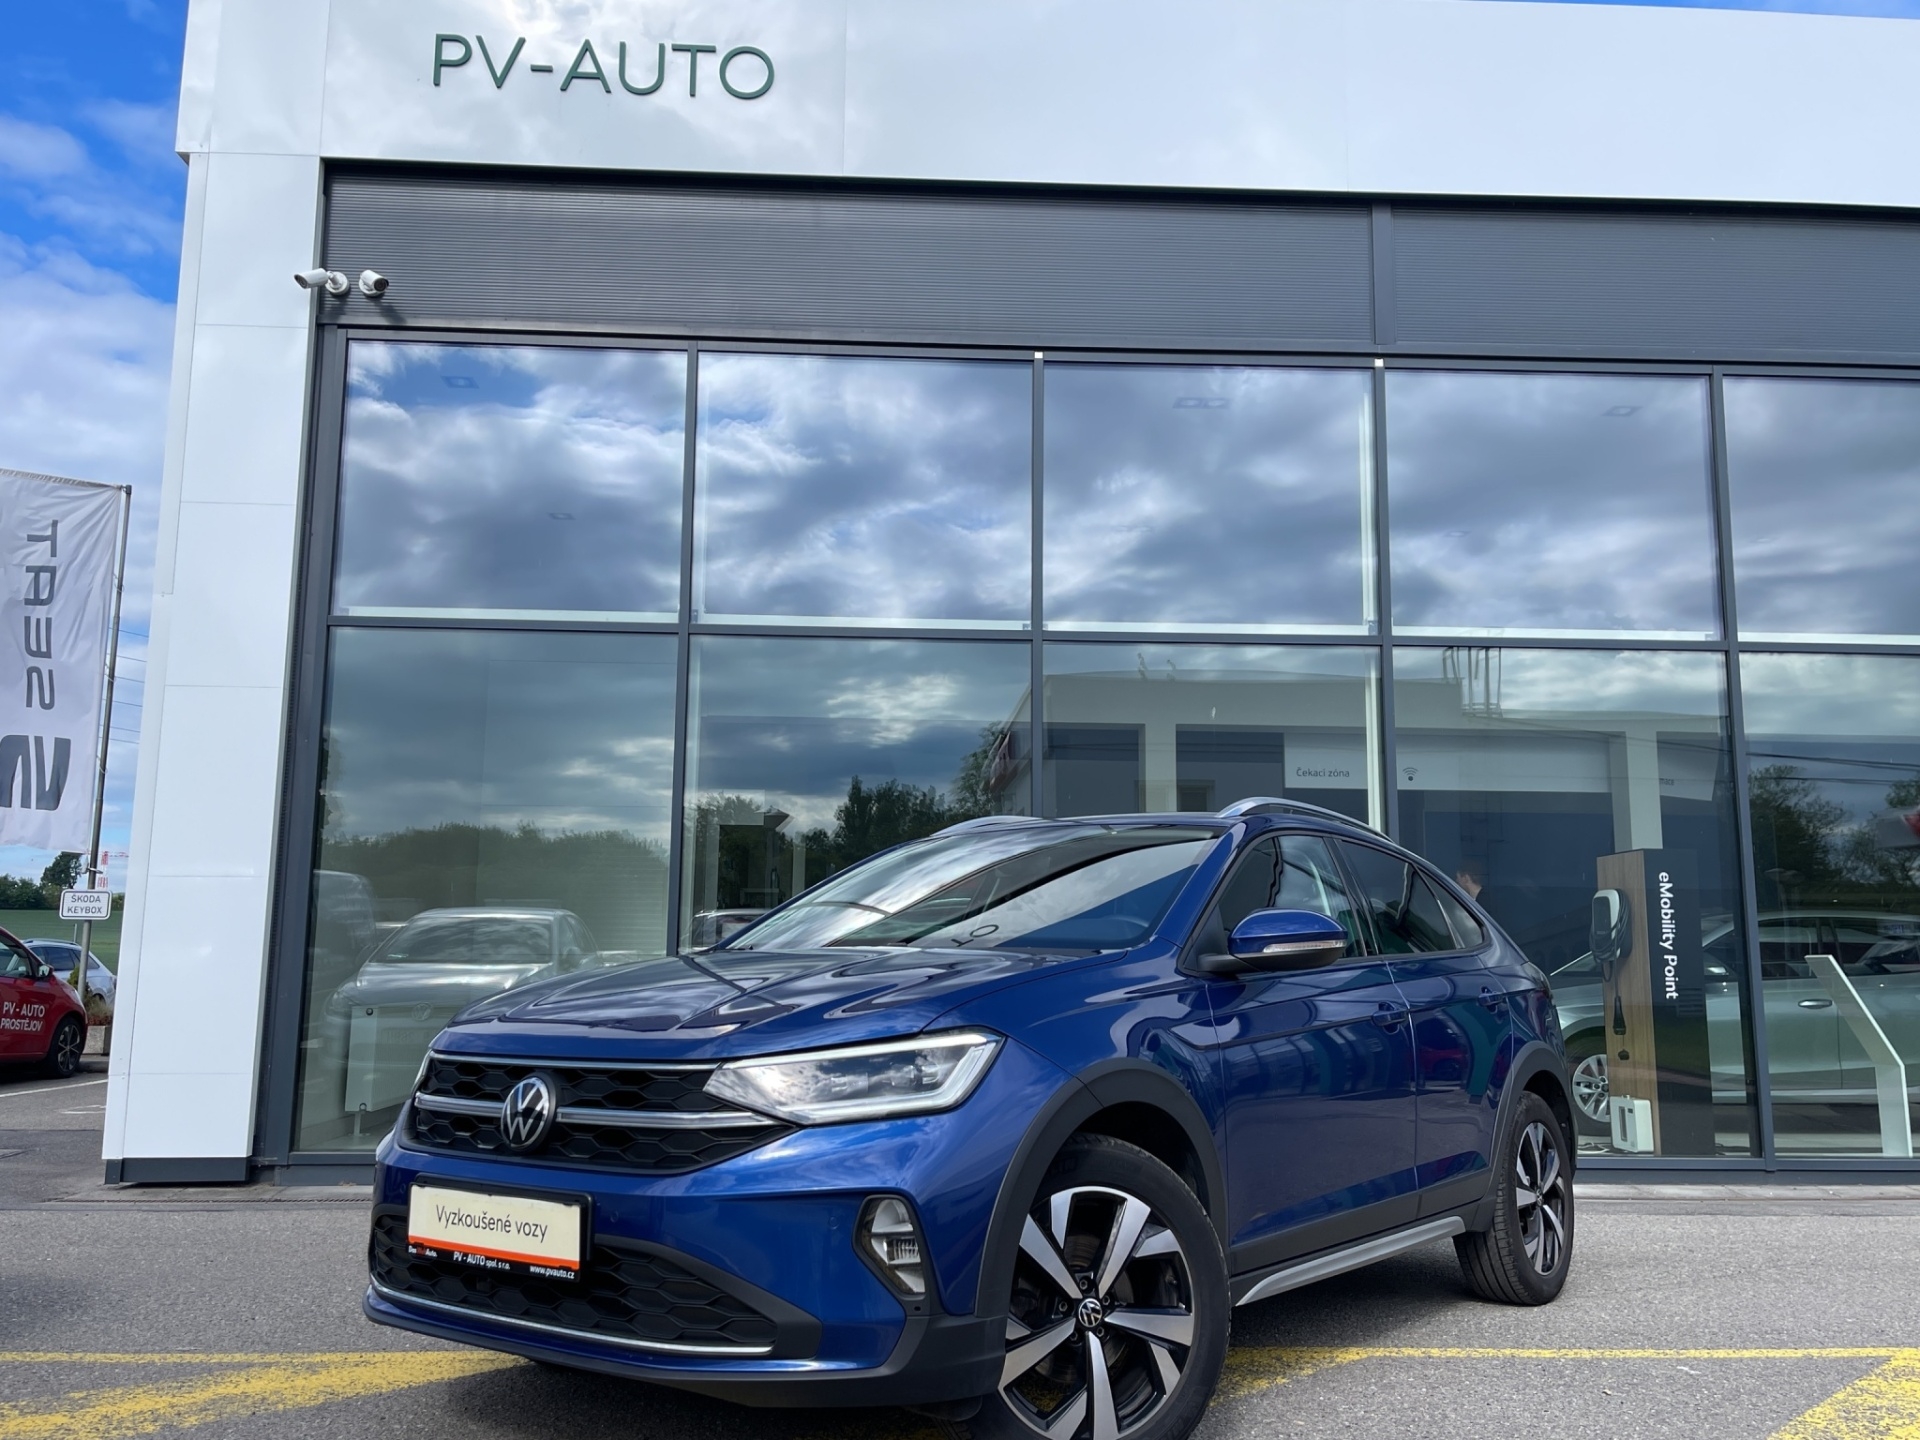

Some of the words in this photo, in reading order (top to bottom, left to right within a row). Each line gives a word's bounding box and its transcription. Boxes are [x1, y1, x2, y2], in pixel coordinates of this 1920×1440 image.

[433, 33, 775, 100] PV-AUTO
[1296, 767, 1326, 777] Čekací
[1328, 769, 1350, 777] zóna
[71, 893, 101, 903] ŠKODA
[67, 906, 103, 915] KEYBOX
[1659, 872, 1676, 950] eMobility
[1663, 954, 1679, 999] Point
[3, 1002, 15, 1015] PV
[21, 1003, 45, 1017] AUTO
[0, 1018, 43, 1031] PROSTĚJOV
[436, 1204, 512, 1233] Vyzkoušené
[515, 1220, 548, 1243] vozy
[453, 1251, 463, 1261] PV
[467, 1253, 485, 1265] AUTO
[529, 1265, 575, 1279] www.pvauto.cz
